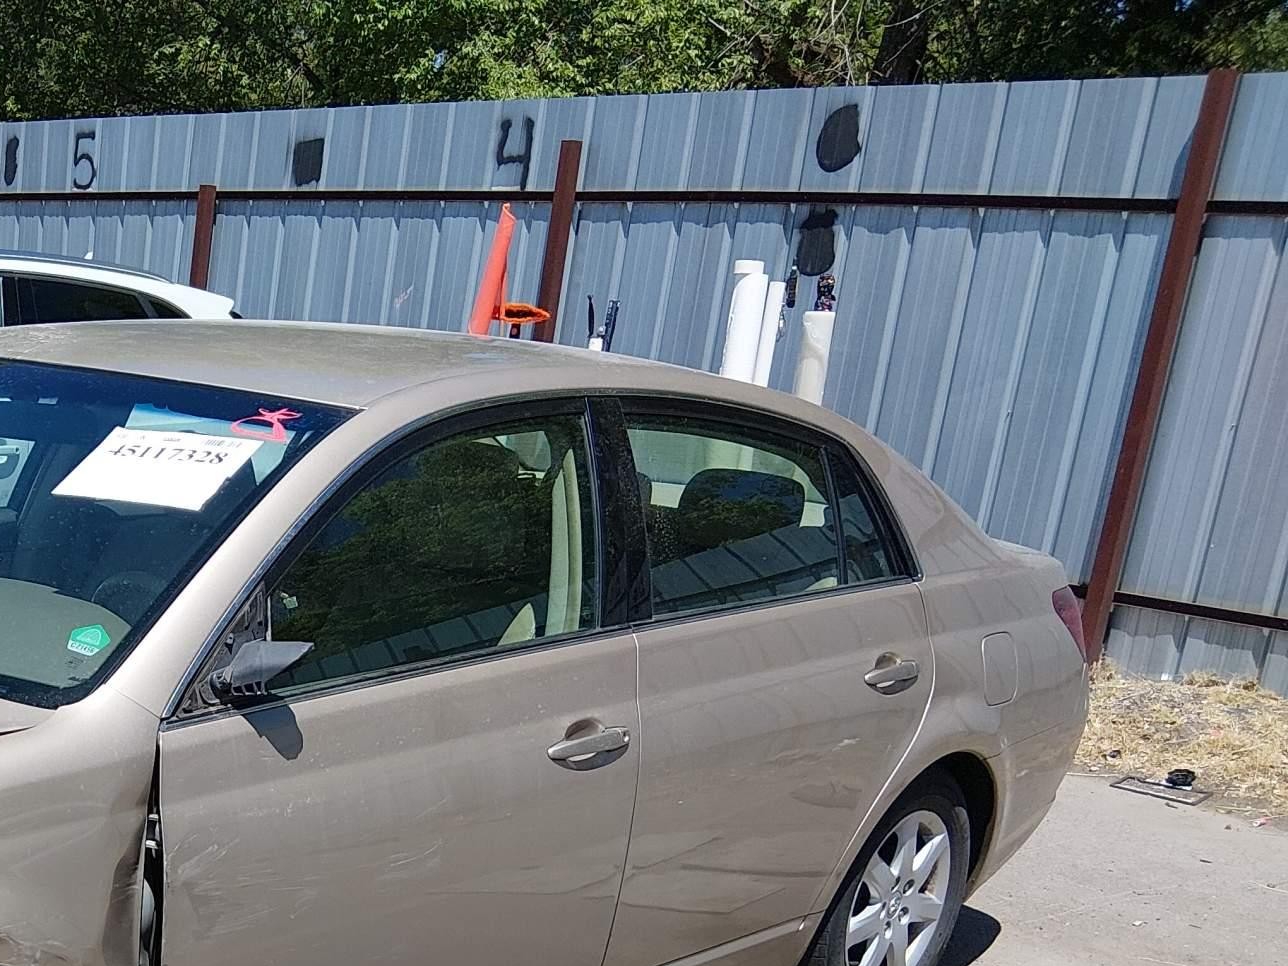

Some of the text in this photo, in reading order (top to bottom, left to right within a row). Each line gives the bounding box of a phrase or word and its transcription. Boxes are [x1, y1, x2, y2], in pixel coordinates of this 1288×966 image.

[73, 131, 97, 190] 5
[496, 116, 535, 191] 4
[107, 444, 229, 464] 45117328
